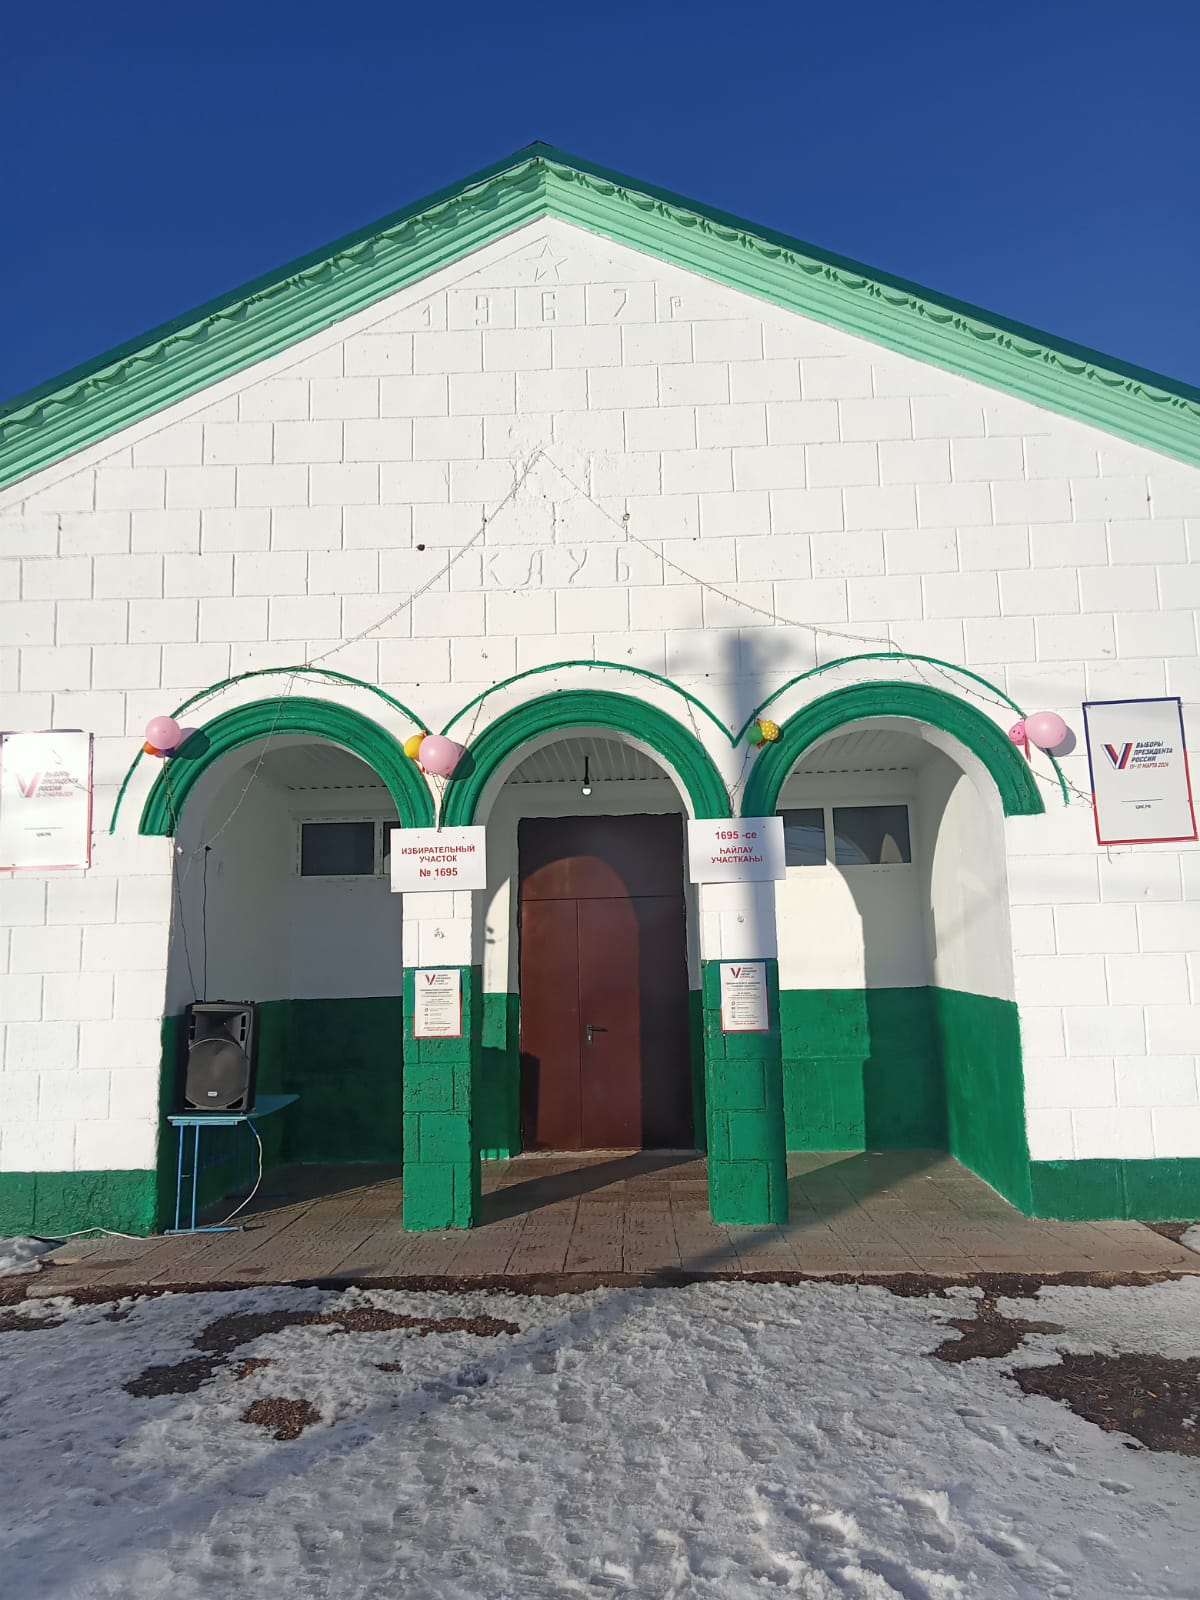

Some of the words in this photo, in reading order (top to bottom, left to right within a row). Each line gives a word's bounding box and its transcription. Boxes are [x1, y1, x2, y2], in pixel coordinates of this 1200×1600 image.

[480, 546, 631, 587] КЛУБ
[1136, 741, 1163, 749] ВЫБОРЫ
[1133, 748, 1173, 756] ПРЕЗИДЕНТА
[715, 831, 739, 840] 1695
[401, 844, 476, 855] ИЗБИРАТЕЛЬНЫЙ
[419, 855, 457, 863] УЧАСТОК
[419, 868, 431, 878] №
[434, 867, 458, 877] 1695
